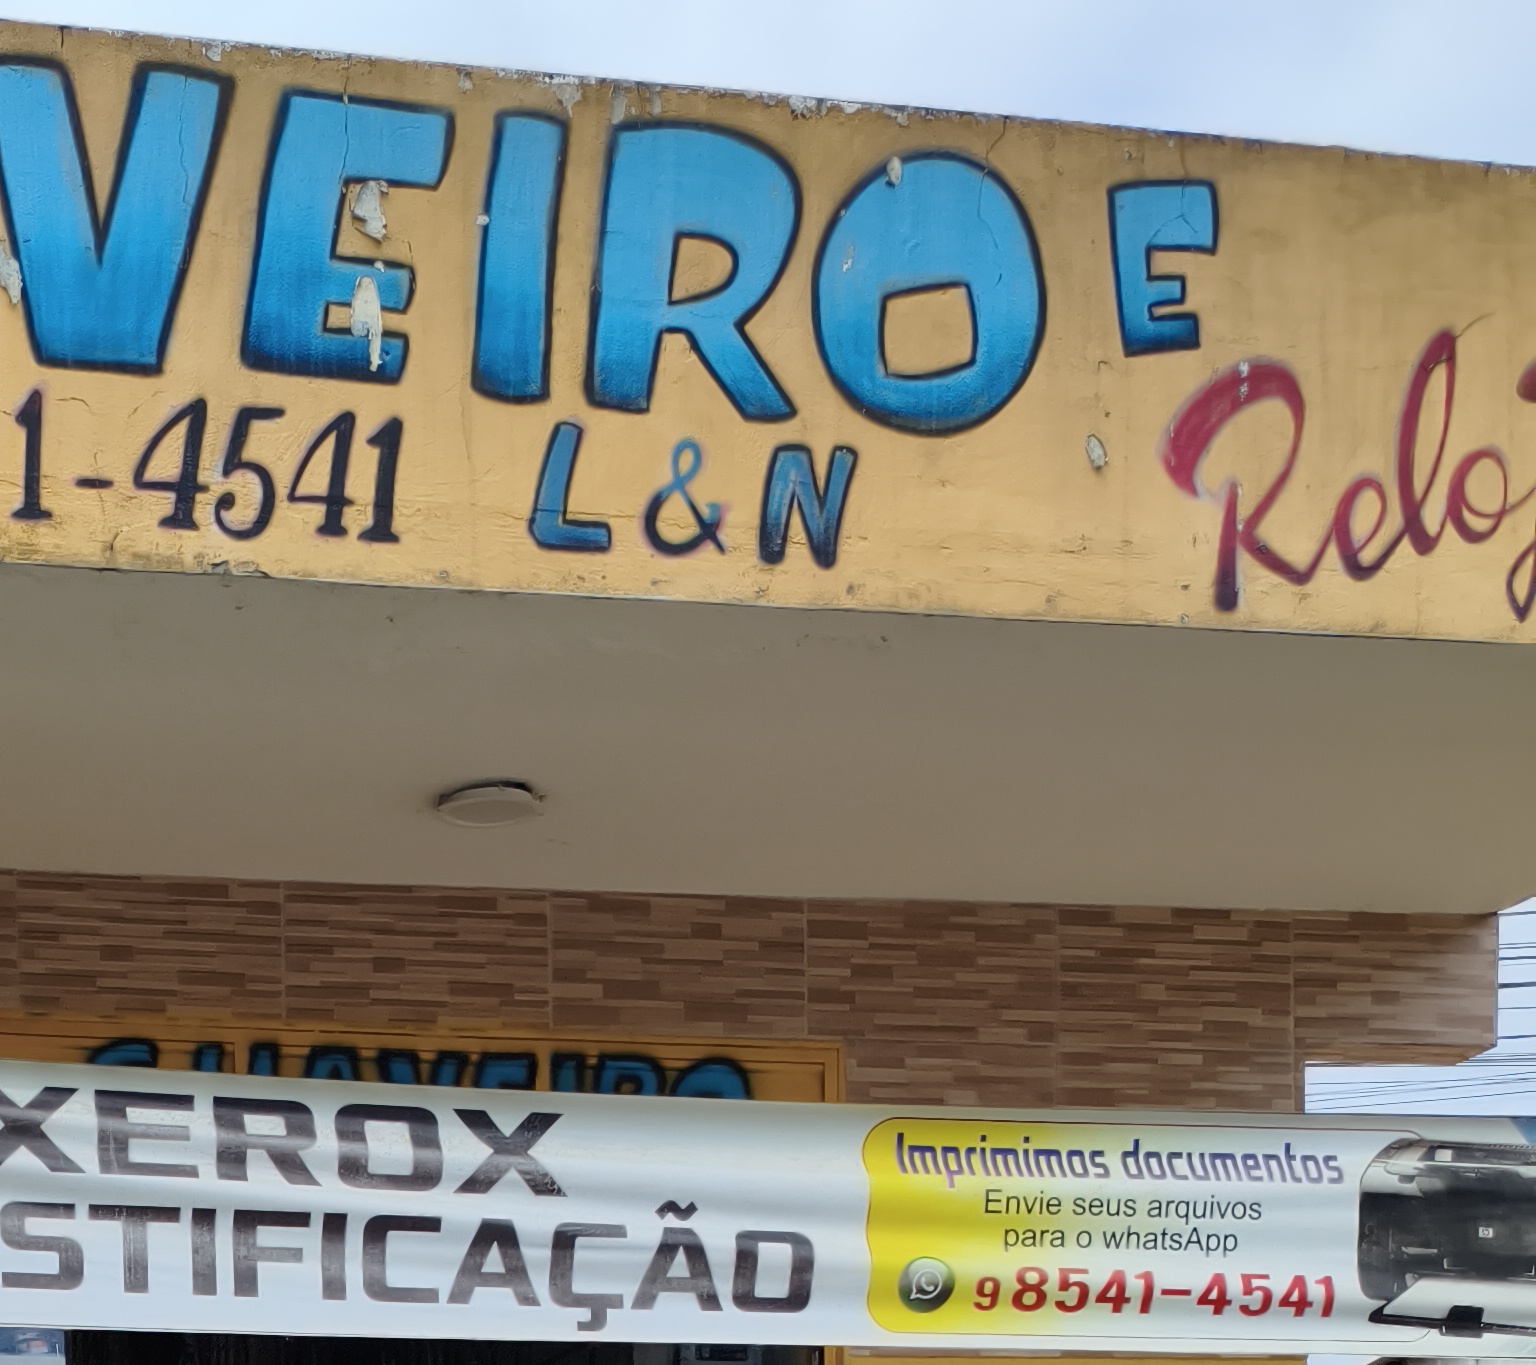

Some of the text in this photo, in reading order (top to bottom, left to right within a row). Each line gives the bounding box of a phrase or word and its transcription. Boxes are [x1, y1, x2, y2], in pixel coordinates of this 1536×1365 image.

[1107, 180, 1219, 358] E
[895, 1131, 1344, 1188] Imprimimos documentos
[983, 1189, 1262, 1226] Envie seus arquivos
[1003, 1227, 1239, 1258] para o whatsApp
